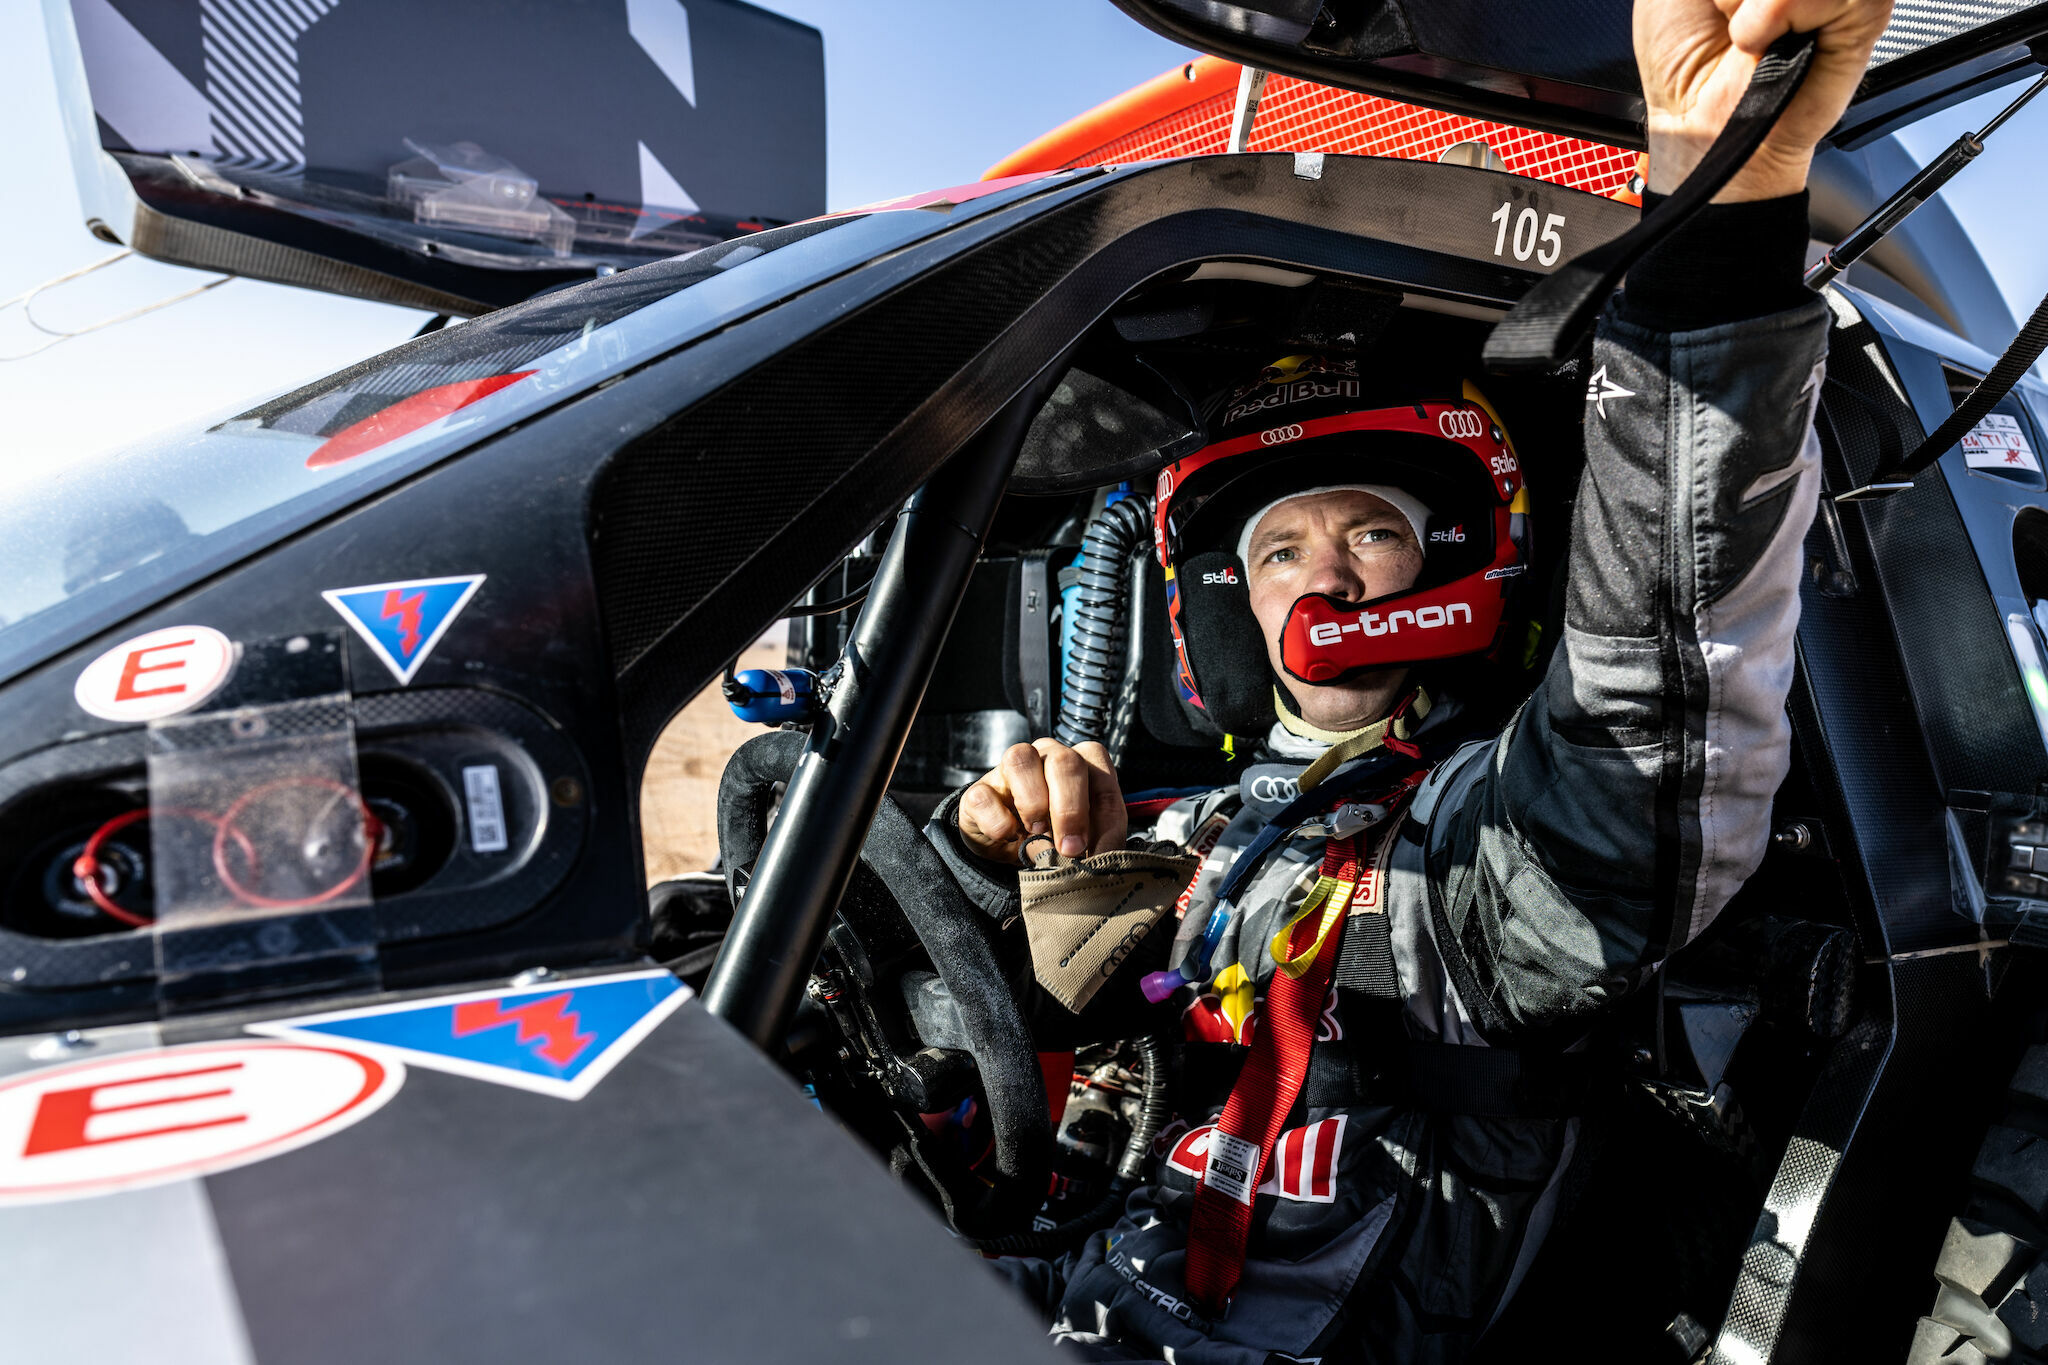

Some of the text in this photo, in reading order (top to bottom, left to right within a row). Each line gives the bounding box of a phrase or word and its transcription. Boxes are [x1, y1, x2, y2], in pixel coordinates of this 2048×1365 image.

[1491, 201, 1566, 267] 105
[1223, 380, 1360, 427] Red Bull
[1490, 449, 1517, 476] stilo
[1430, 526, 1466, 543] stilo
[1202, 568, 1239, 585] stilo
[1309, 602, 1472, 647] e-tron
[114, 639, 196, 702] E
[22, 1062, 249, 1160] E
